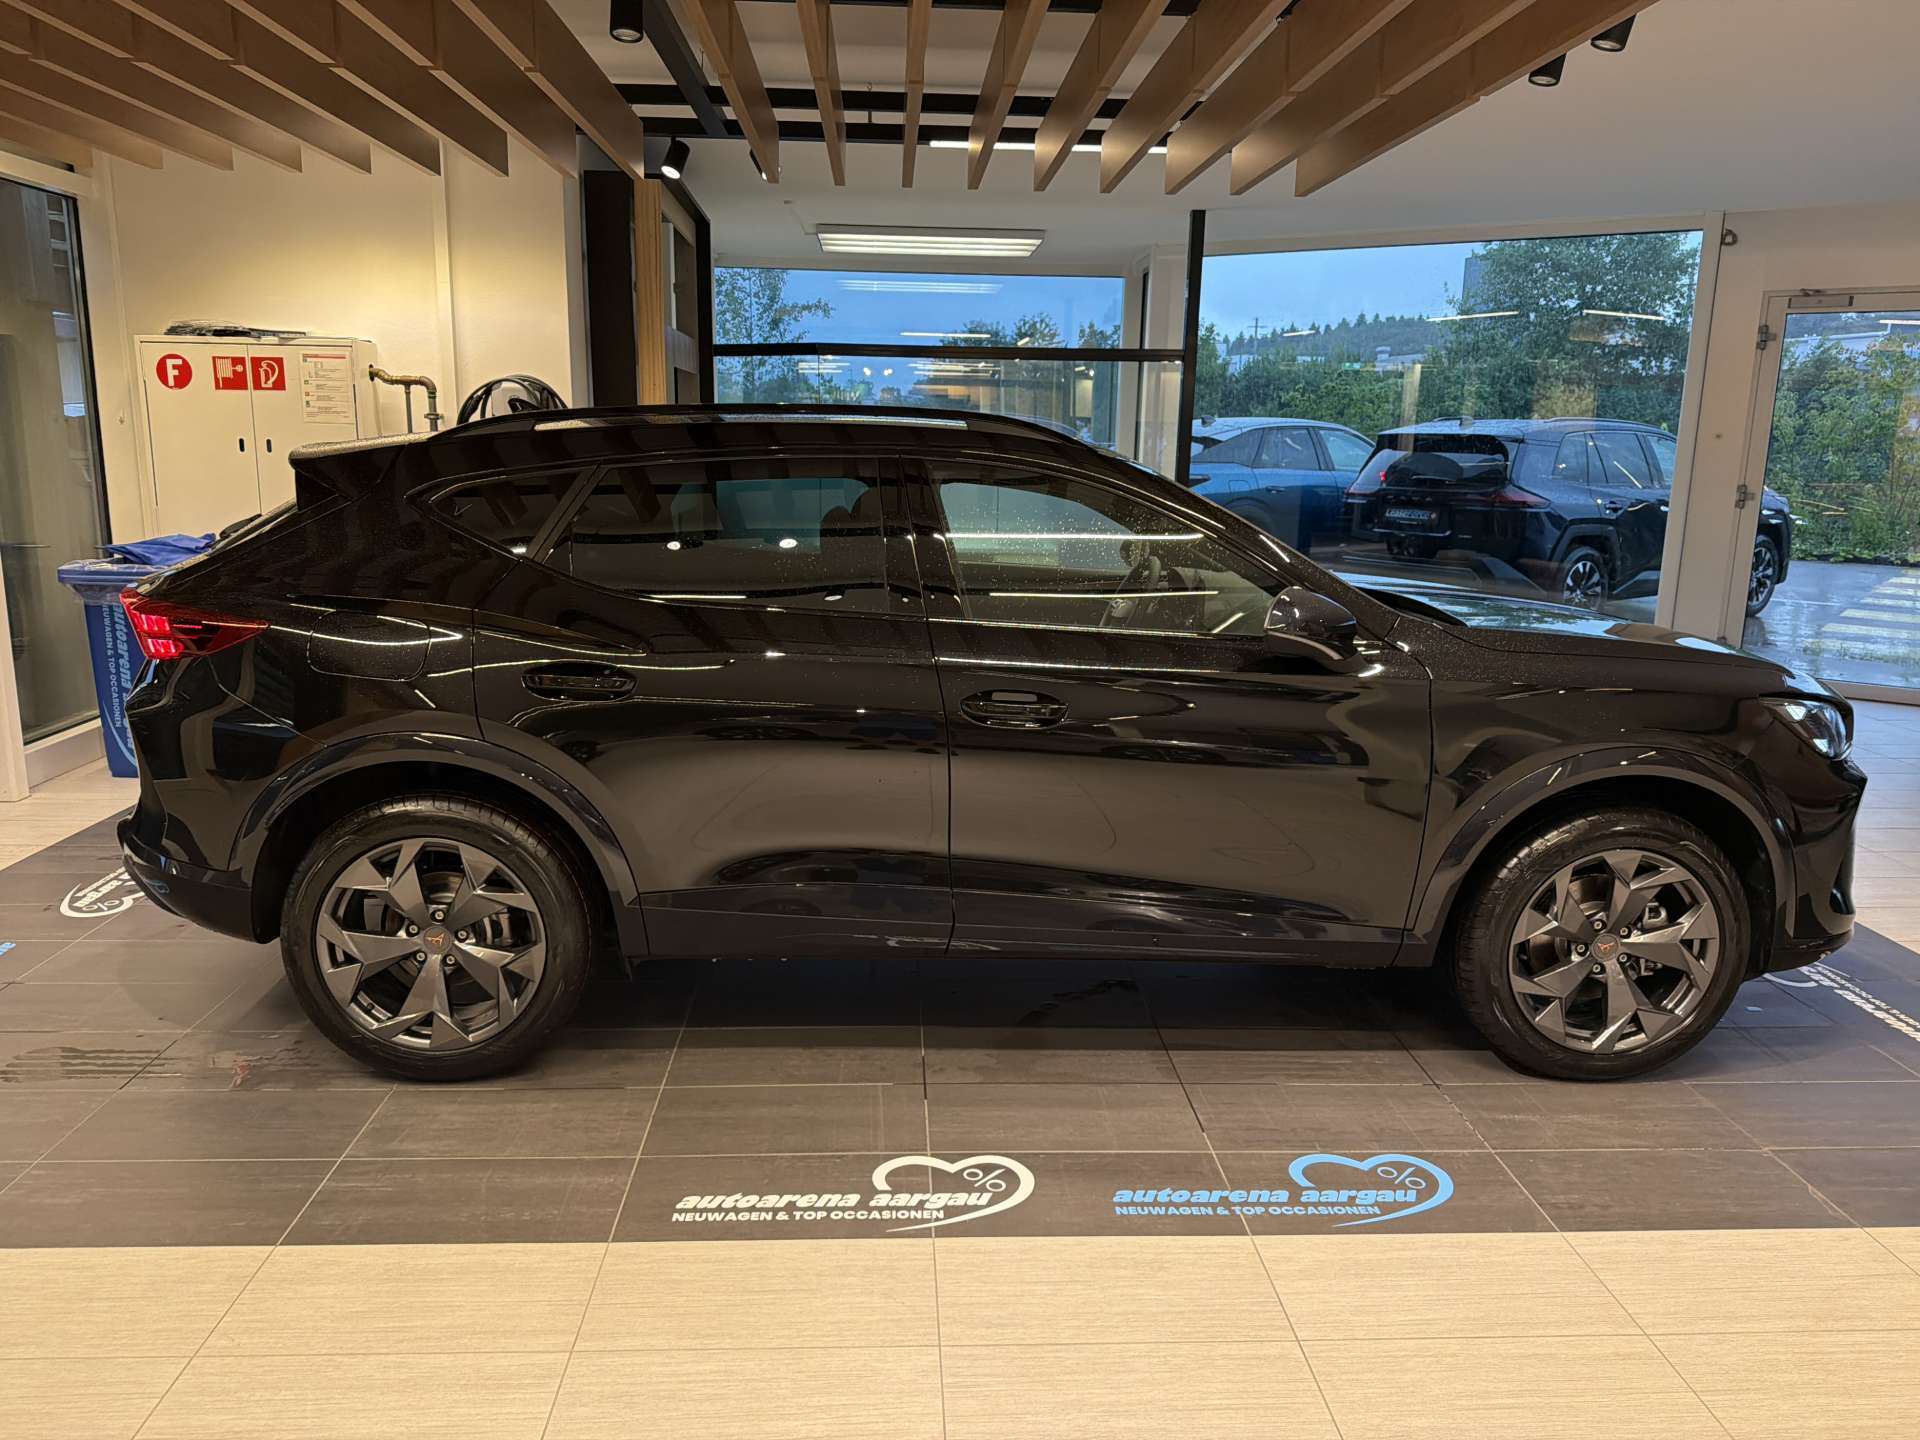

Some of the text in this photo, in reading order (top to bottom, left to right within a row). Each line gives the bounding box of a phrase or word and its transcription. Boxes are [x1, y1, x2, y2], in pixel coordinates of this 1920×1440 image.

[166, 358, 183, 387] F
[108, 657, 116, 674] TOP
[675, 1192, 993, 1209] autoarena aargau
[1112, 1187, 1417, 1205] autoarena aargau
[672, 1210, 944, 1222] NEUWAGEN & TOP OCCASIONEN
[1114, 1206, 1382, 1216] NEUWAGEN & TOP OCCASIONEN
